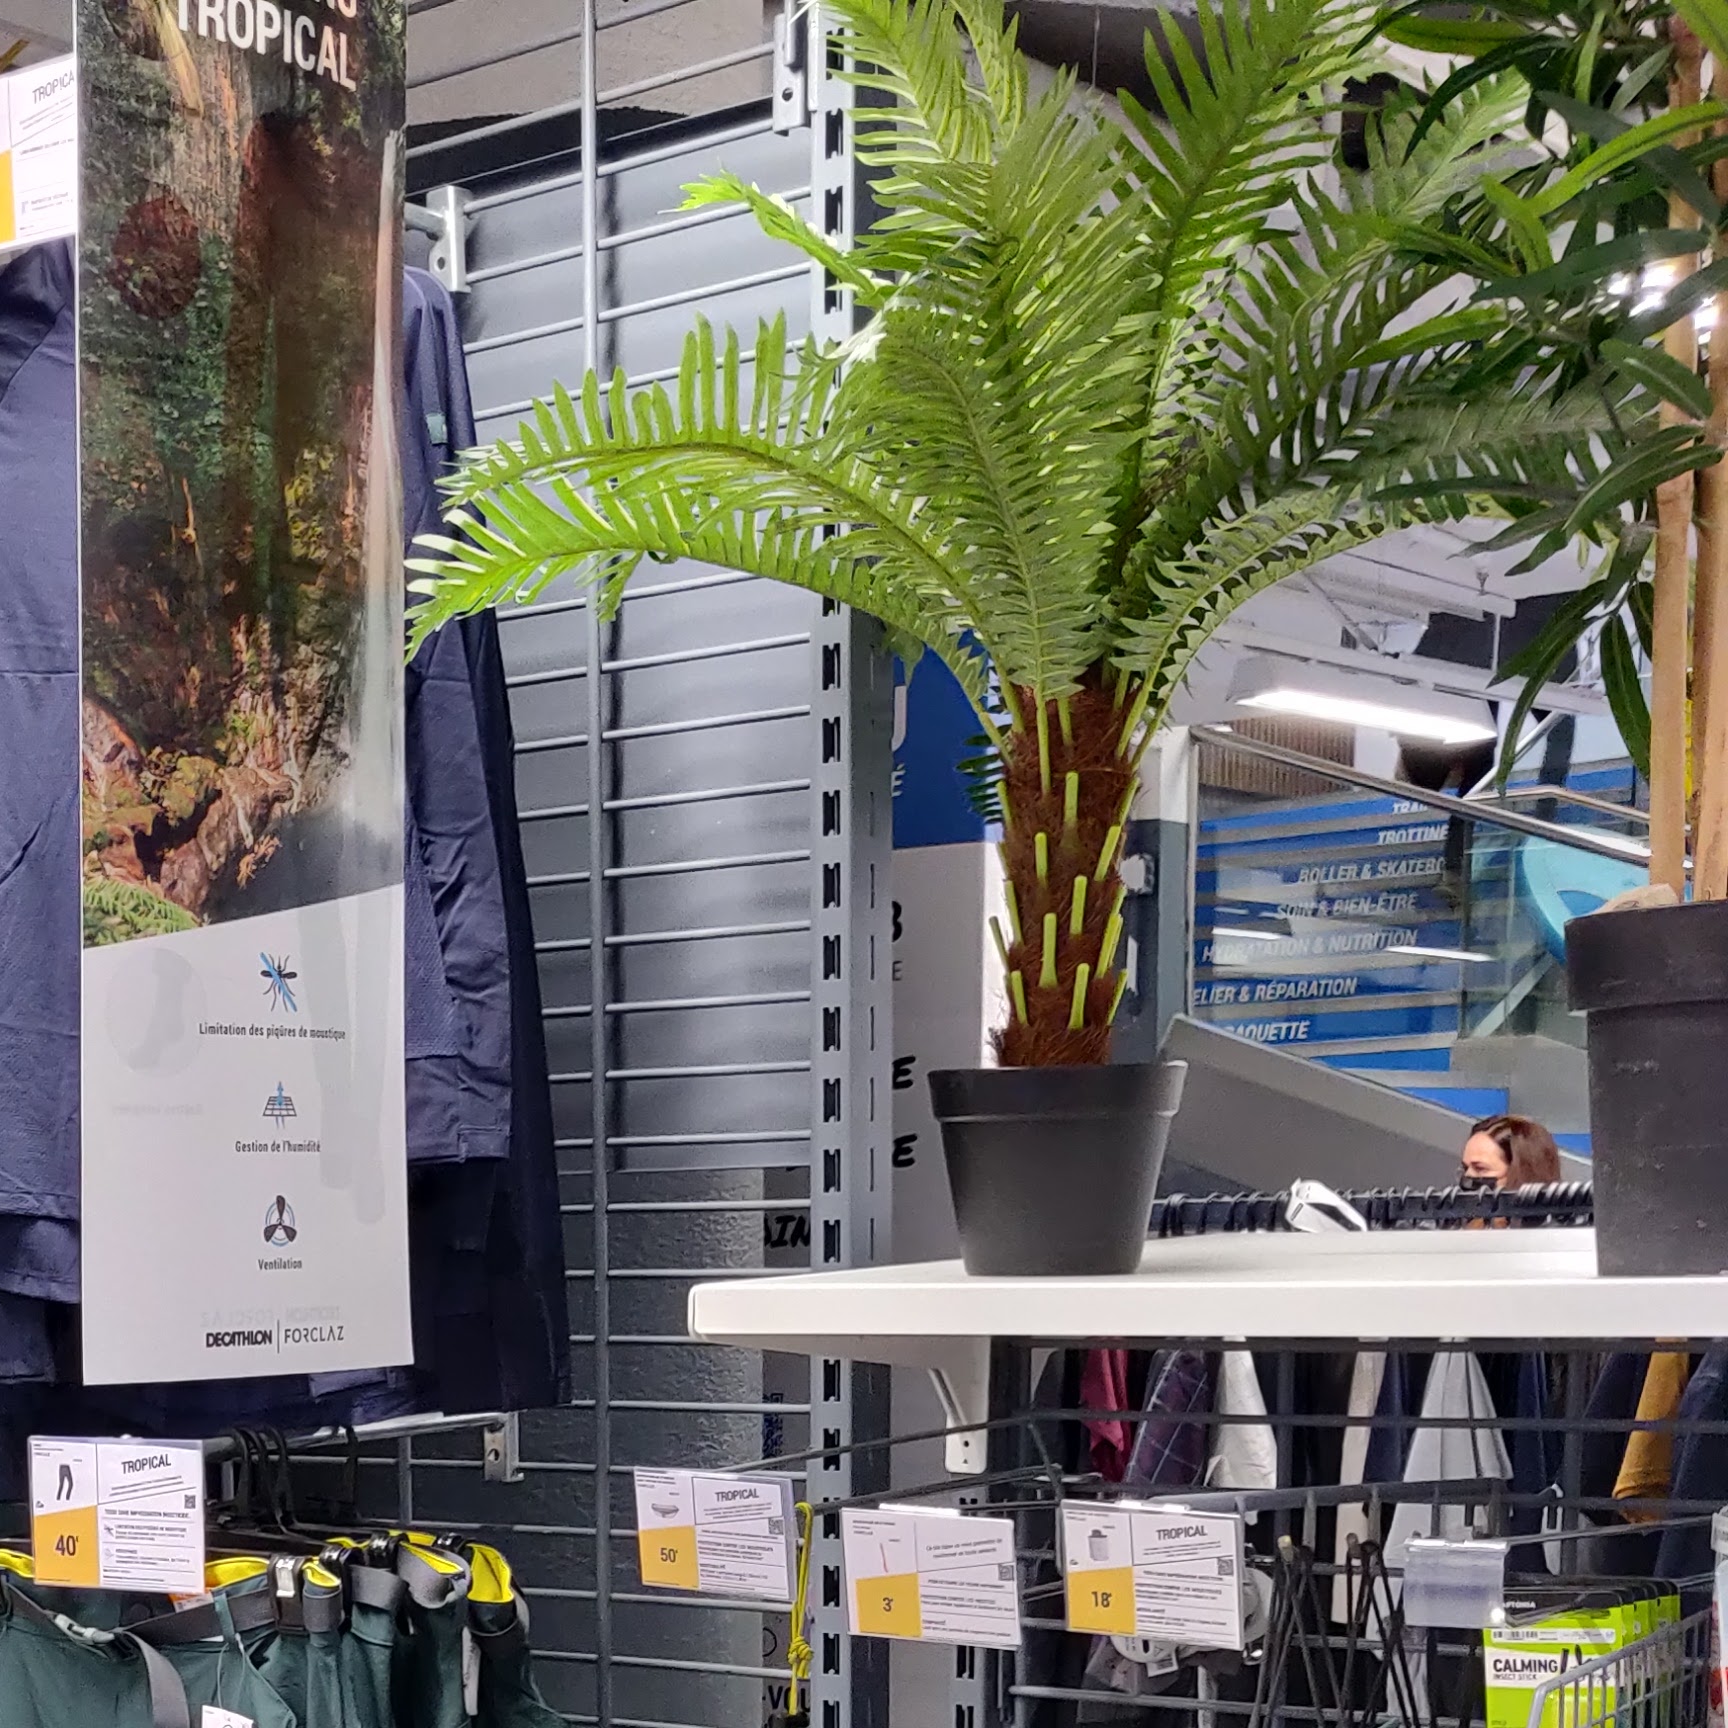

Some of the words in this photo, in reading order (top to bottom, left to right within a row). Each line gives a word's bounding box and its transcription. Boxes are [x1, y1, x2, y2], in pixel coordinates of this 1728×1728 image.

[32, 70, 75, 104] TROPICA
[1326, 929, 1419, 952] NUTRITION
[1239, 987, 1250, 1003] &
[1255, 976, 1358, 1001] RÉPARATION
[199, 1022, 246, 1036] Limitation
[249, 1023, 264, 1036] des
[266, 1024, 296, 1040] piqûres
[298, 1025, 308, 1038] de
[309, 1027, 346, 1042] moustique
[235, 1140, 269, 1153] Gestion
[271, 1139, 281, 1153] de
[258, 1257, 303, 1271] Ventilation
[205, 1329, 272, 1348] DECATHLON
[284, 1325, 344, 1344] FORCLAZ
[121, 1453, 171, 1475] TROPICAL
[714, 1488, 760, 1503] TROPICAL
[1156, 1525, 1208, 1541] TROPICAL
[1493, 1658, 1558, 1674] CALMING
